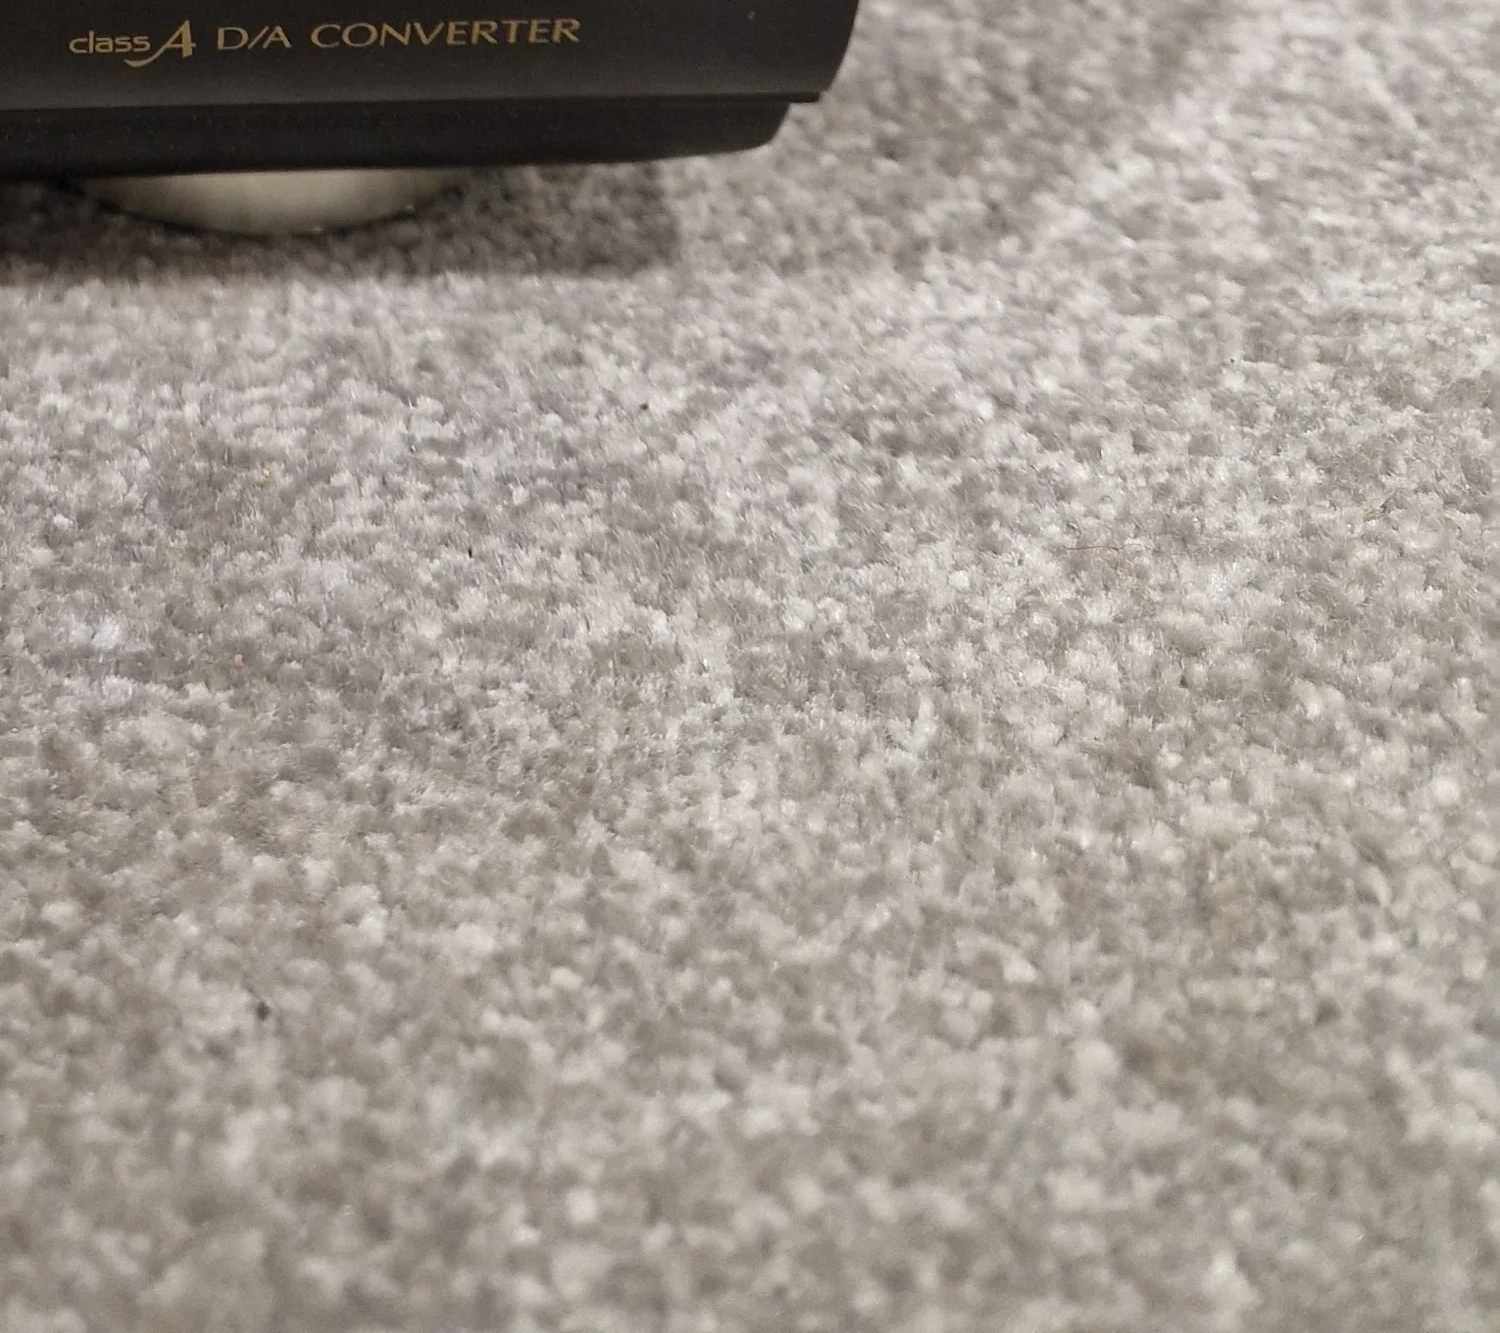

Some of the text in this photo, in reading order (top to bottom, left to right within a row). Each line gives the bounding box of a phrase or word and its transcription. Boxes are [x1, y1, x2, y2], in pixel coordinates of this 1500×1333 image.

[69, 30, 151, 54] class
[217, 25, 293, 50] D/A
[311, 17, 581, 49] CONVERTER
